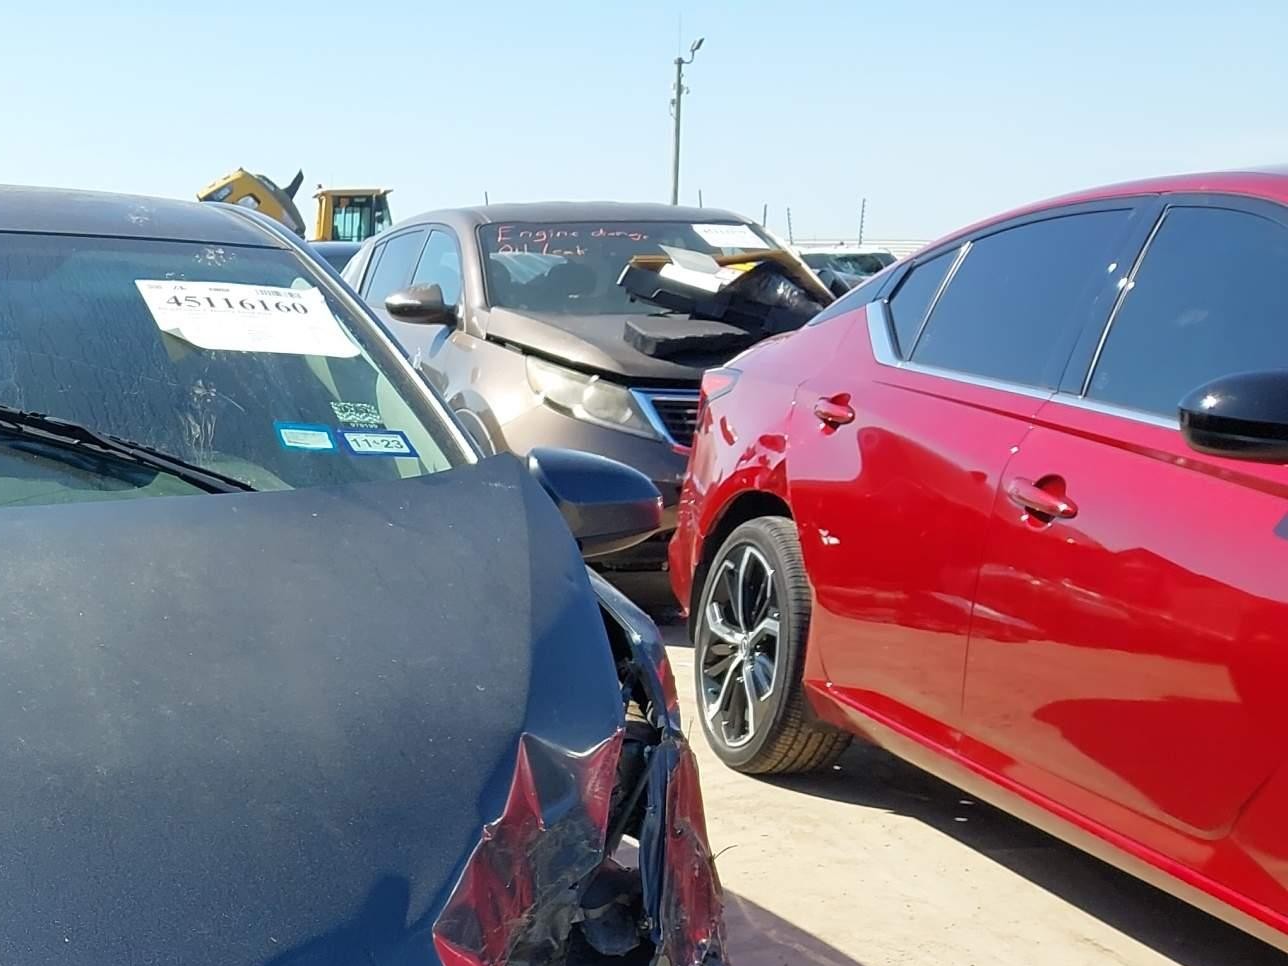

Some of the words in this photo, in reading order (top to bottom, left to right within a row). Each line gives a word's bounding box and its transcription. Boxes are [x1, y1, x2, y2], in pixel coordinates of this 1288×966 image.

[497, 226, 579, 243] Engine
[166, 294, 309, 316] 45116160
[380, 439, 404, 449] 23
